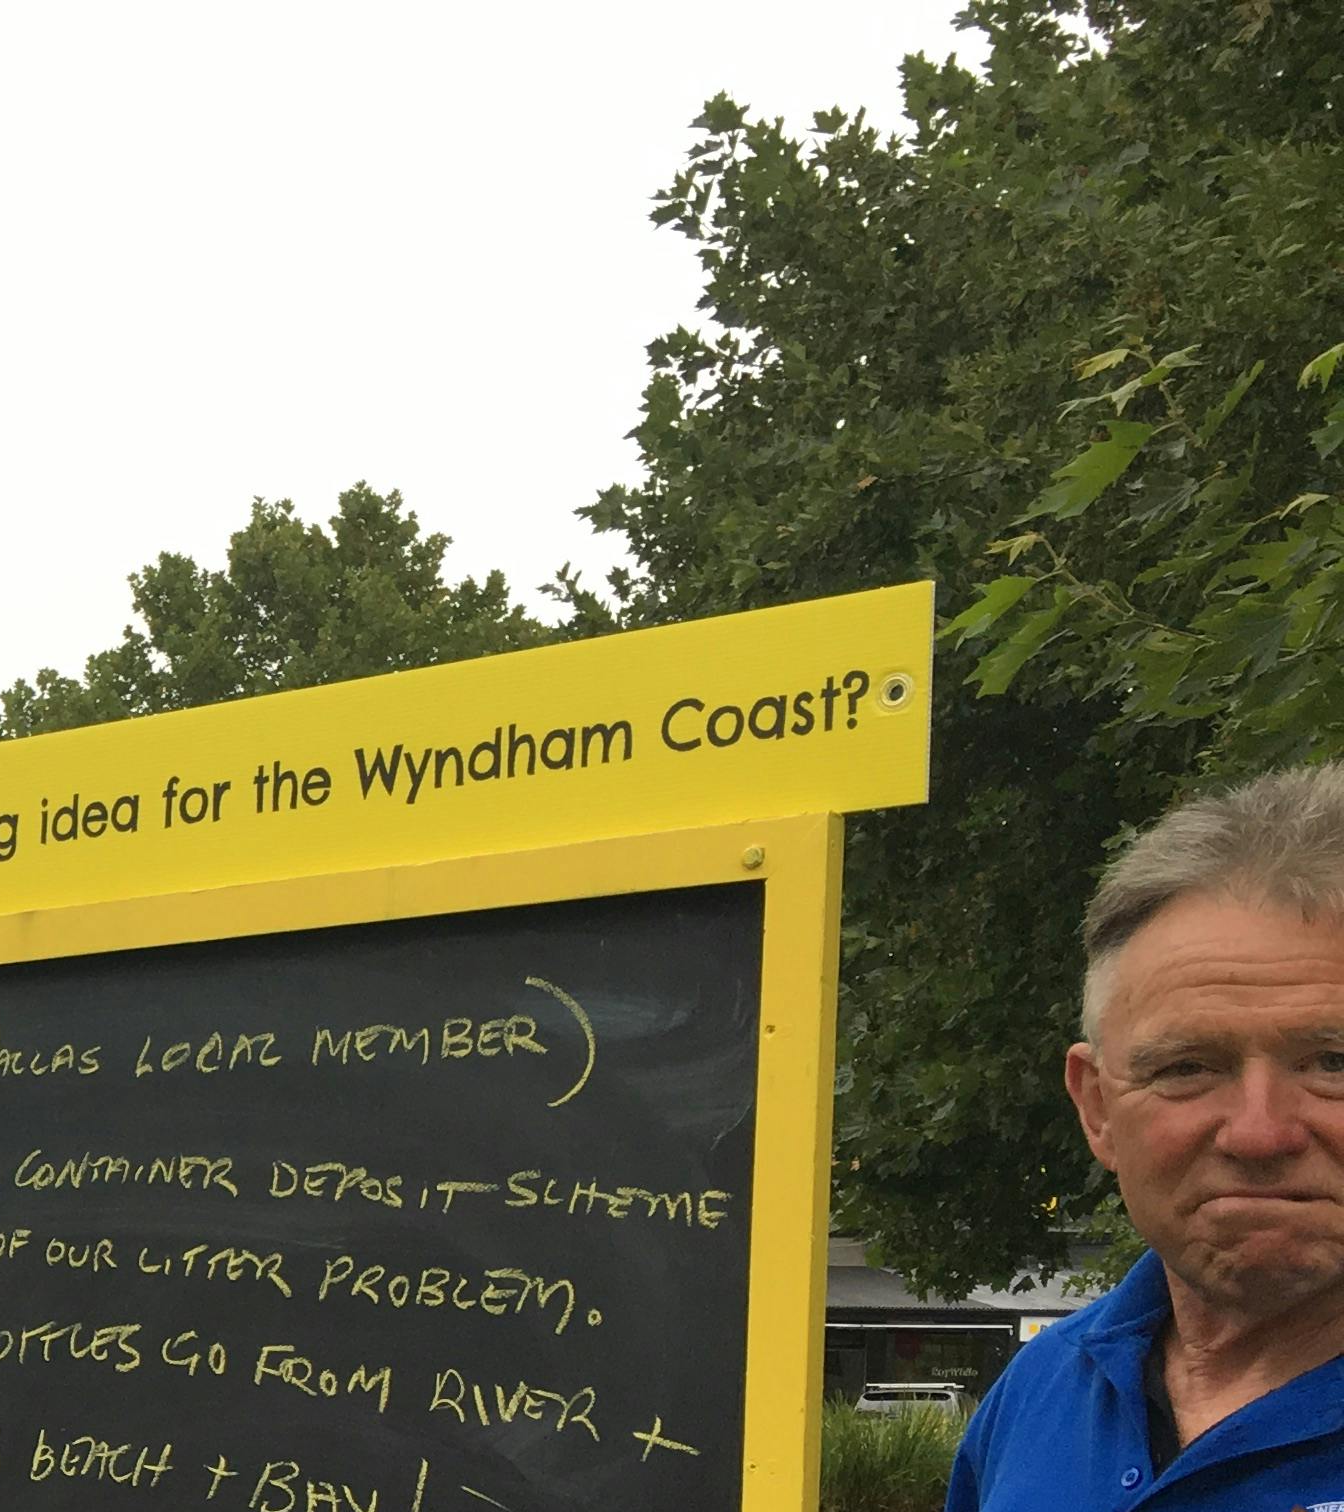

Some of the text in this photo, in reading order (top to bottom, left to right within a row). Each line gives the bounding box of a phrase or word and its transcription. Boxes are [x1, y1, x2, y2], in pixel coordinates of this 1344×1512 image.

[40, 794, 139, 845] idea
[162, 776, 230, 829] for
[255, 761, 331, 814] the
[354, 720, 633, 806] Wyndham
[661, 669, 872, 753] Coast?
[135, 1030, 282, 1079] LOCAL
[15, 1149, 238, 1199] CONTAINER
[45, 1238, 117, 1271] OUR
[137, 1244, 293, 1299] LITTER
[162, 1329, 226, 1377] GO
[254, 1344, 392, 1413] FROM
[429, 1368, 599, 1442] RIVER
[30, 1429, 174, 1487] BEACH
